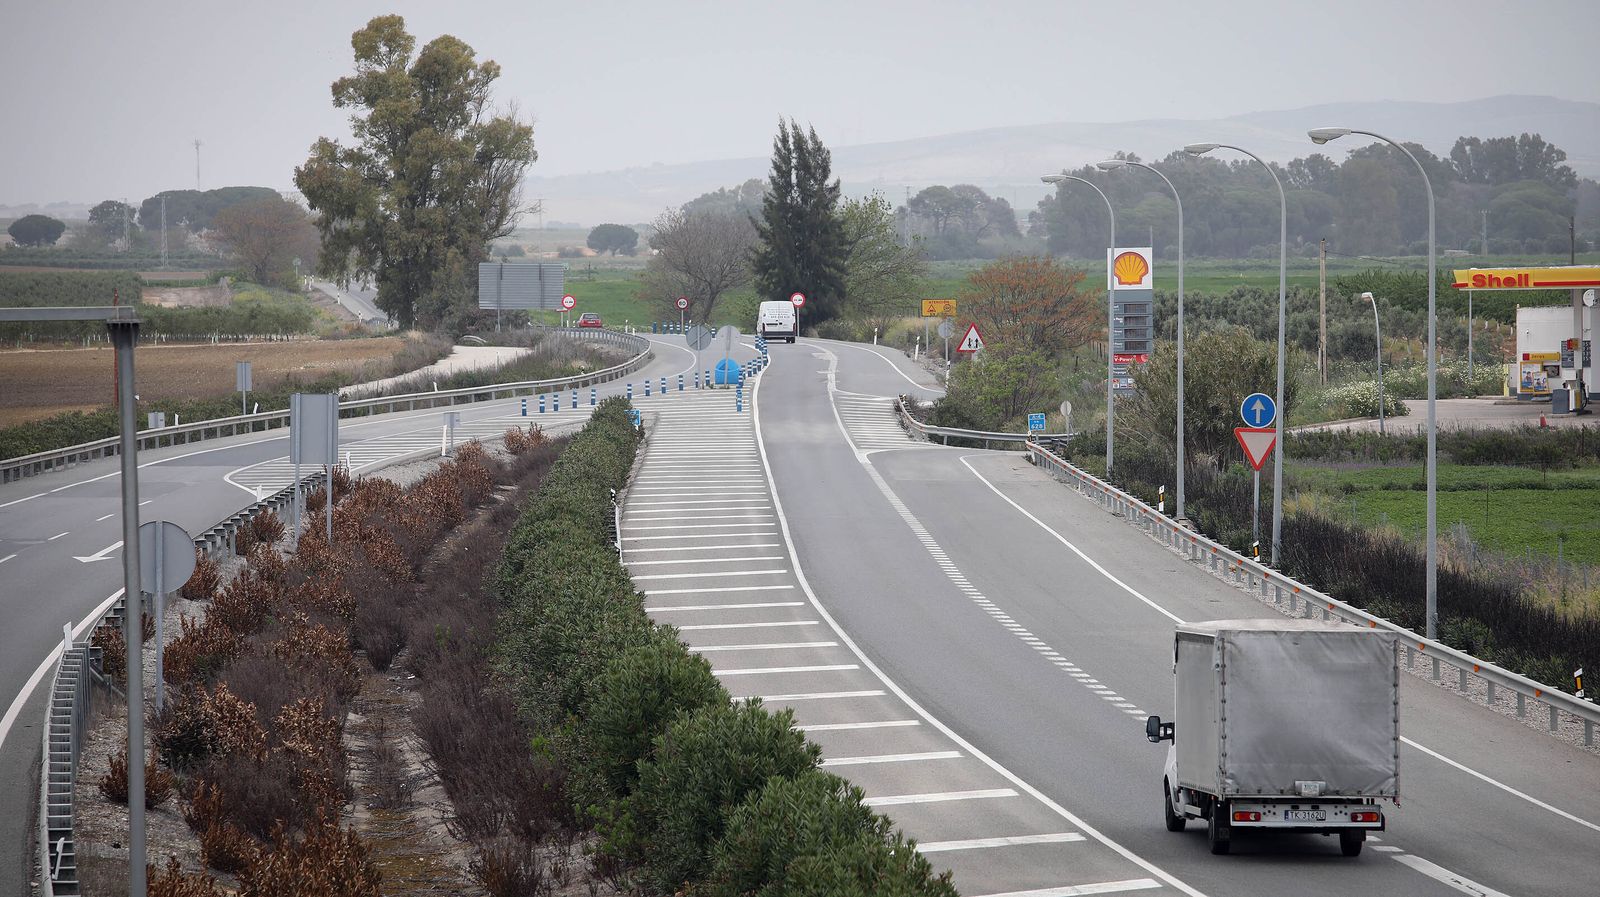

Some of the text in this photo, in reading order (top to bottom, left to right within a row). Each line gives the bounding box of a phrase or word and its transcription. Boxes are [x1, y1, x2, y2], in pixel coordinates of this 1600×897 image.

[1472, 273, 1529, 288] Shell
[1290, 811, 1325, 820] TK 3162U
